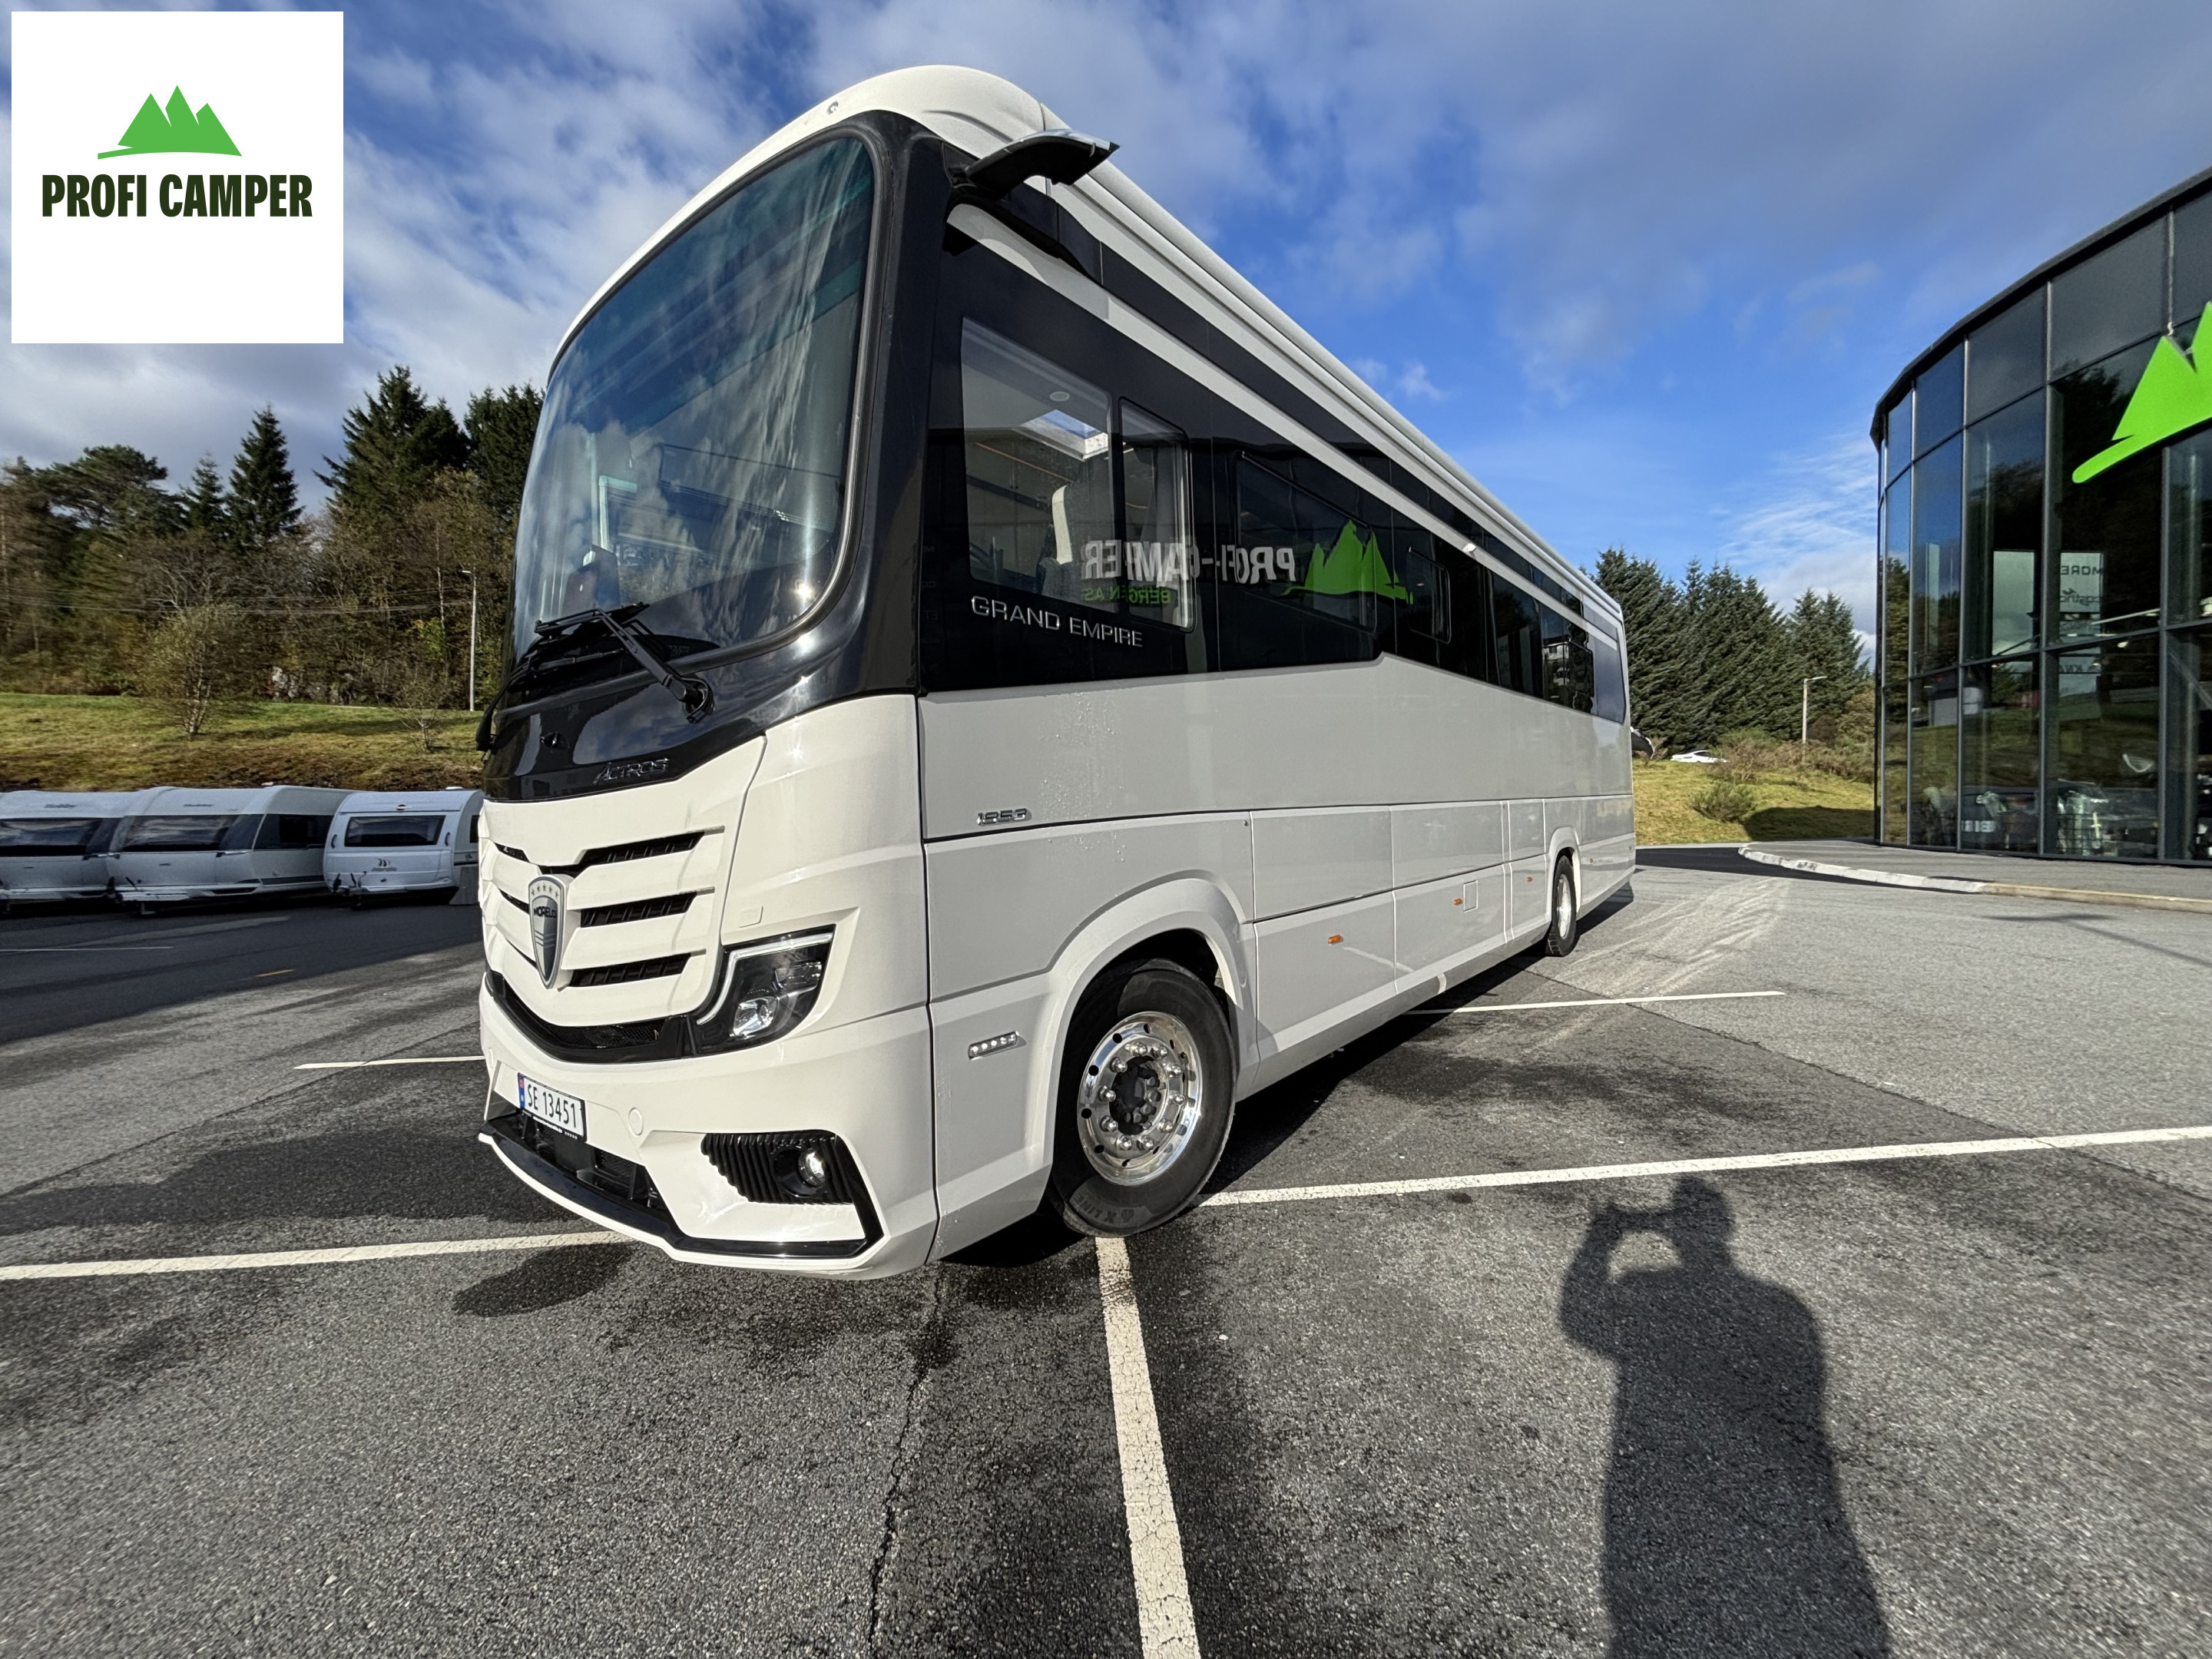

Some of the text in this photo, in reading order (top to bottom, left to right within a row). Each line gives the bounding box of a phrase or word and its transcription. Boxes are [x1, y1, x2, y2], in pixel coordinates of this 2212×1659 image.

[971, 595, 1143, 647] GRAND EMPIRE
[591, 757, 670, 786] ACTROS
[533, 906, 557, 919] MORELO
[528, 1084, 538, 1111] SE
[542, 1091, 577, 1128] 13451
